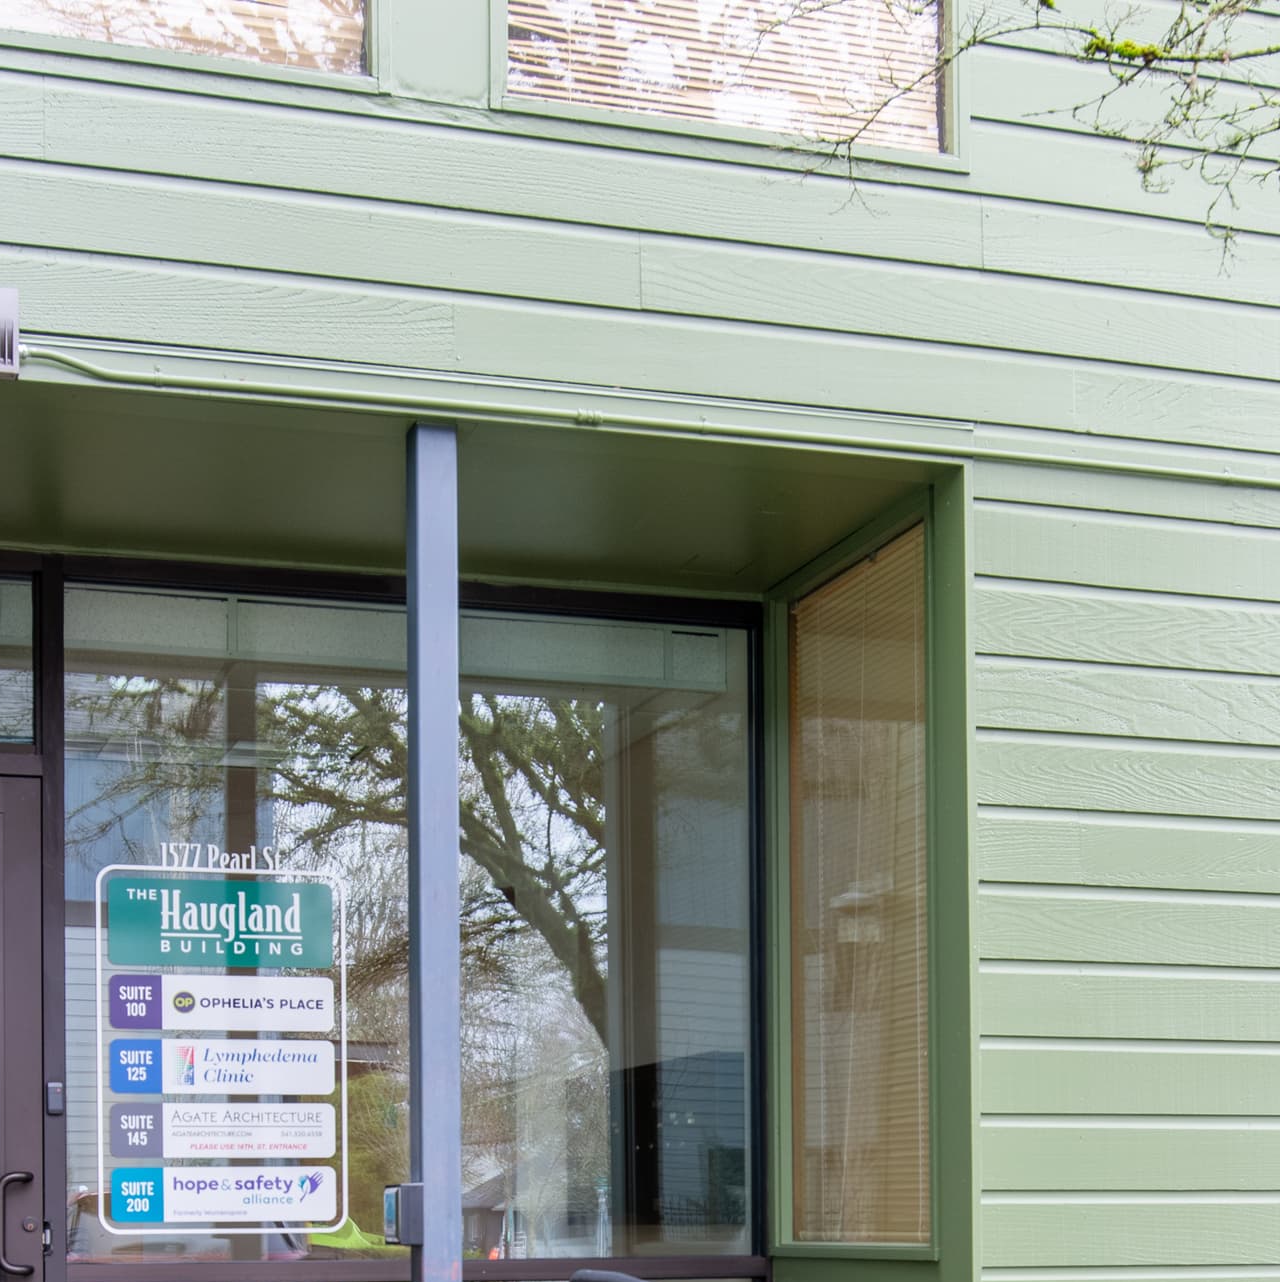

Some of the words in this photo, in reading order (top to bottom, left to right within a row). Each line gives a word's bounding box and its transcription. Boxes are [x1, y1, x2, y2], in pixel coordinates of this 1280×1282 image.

[160, 842, 201, 868] 1577
[208, 844, 256, 869] Pearl
[126, 888, 157, 901] THE
[160, 889, 302, 942] Haugland
[160, 940, 303, 955] BUILDING
[119, 986, 152, 1001] SUITE
[126, 1002, 146, 1017] 100
[175, 997, 193, 1007] OP
[200, 997, 274, 1009] OPHELIA'S
[280, 999, 324, 1010] PLACE
[120, 1050, 153, 1065] SUITE
[204, 1048, 318, 1066] Lymphedema
[126, 1067, 147, 1081] 125
[204, 1069, 255, 1083] Clinic
[121, 1114, 153, 1129] SUITE
[171, 1110, 217, 1123] AGATE
[222, 1110, 322, 1123] ARCHITECTURE
[127, 1131, 148, 1146] 145
[121, 1181, 154, 1196] SUITE
[173, 1177, 219, 1194] hope
[220, 1179, 232, 1191] &
[235, 1175, 293, 1193] safety
[126, 1198, 149, 1212] 200
[243, 1194, 293, 1205] alliance
